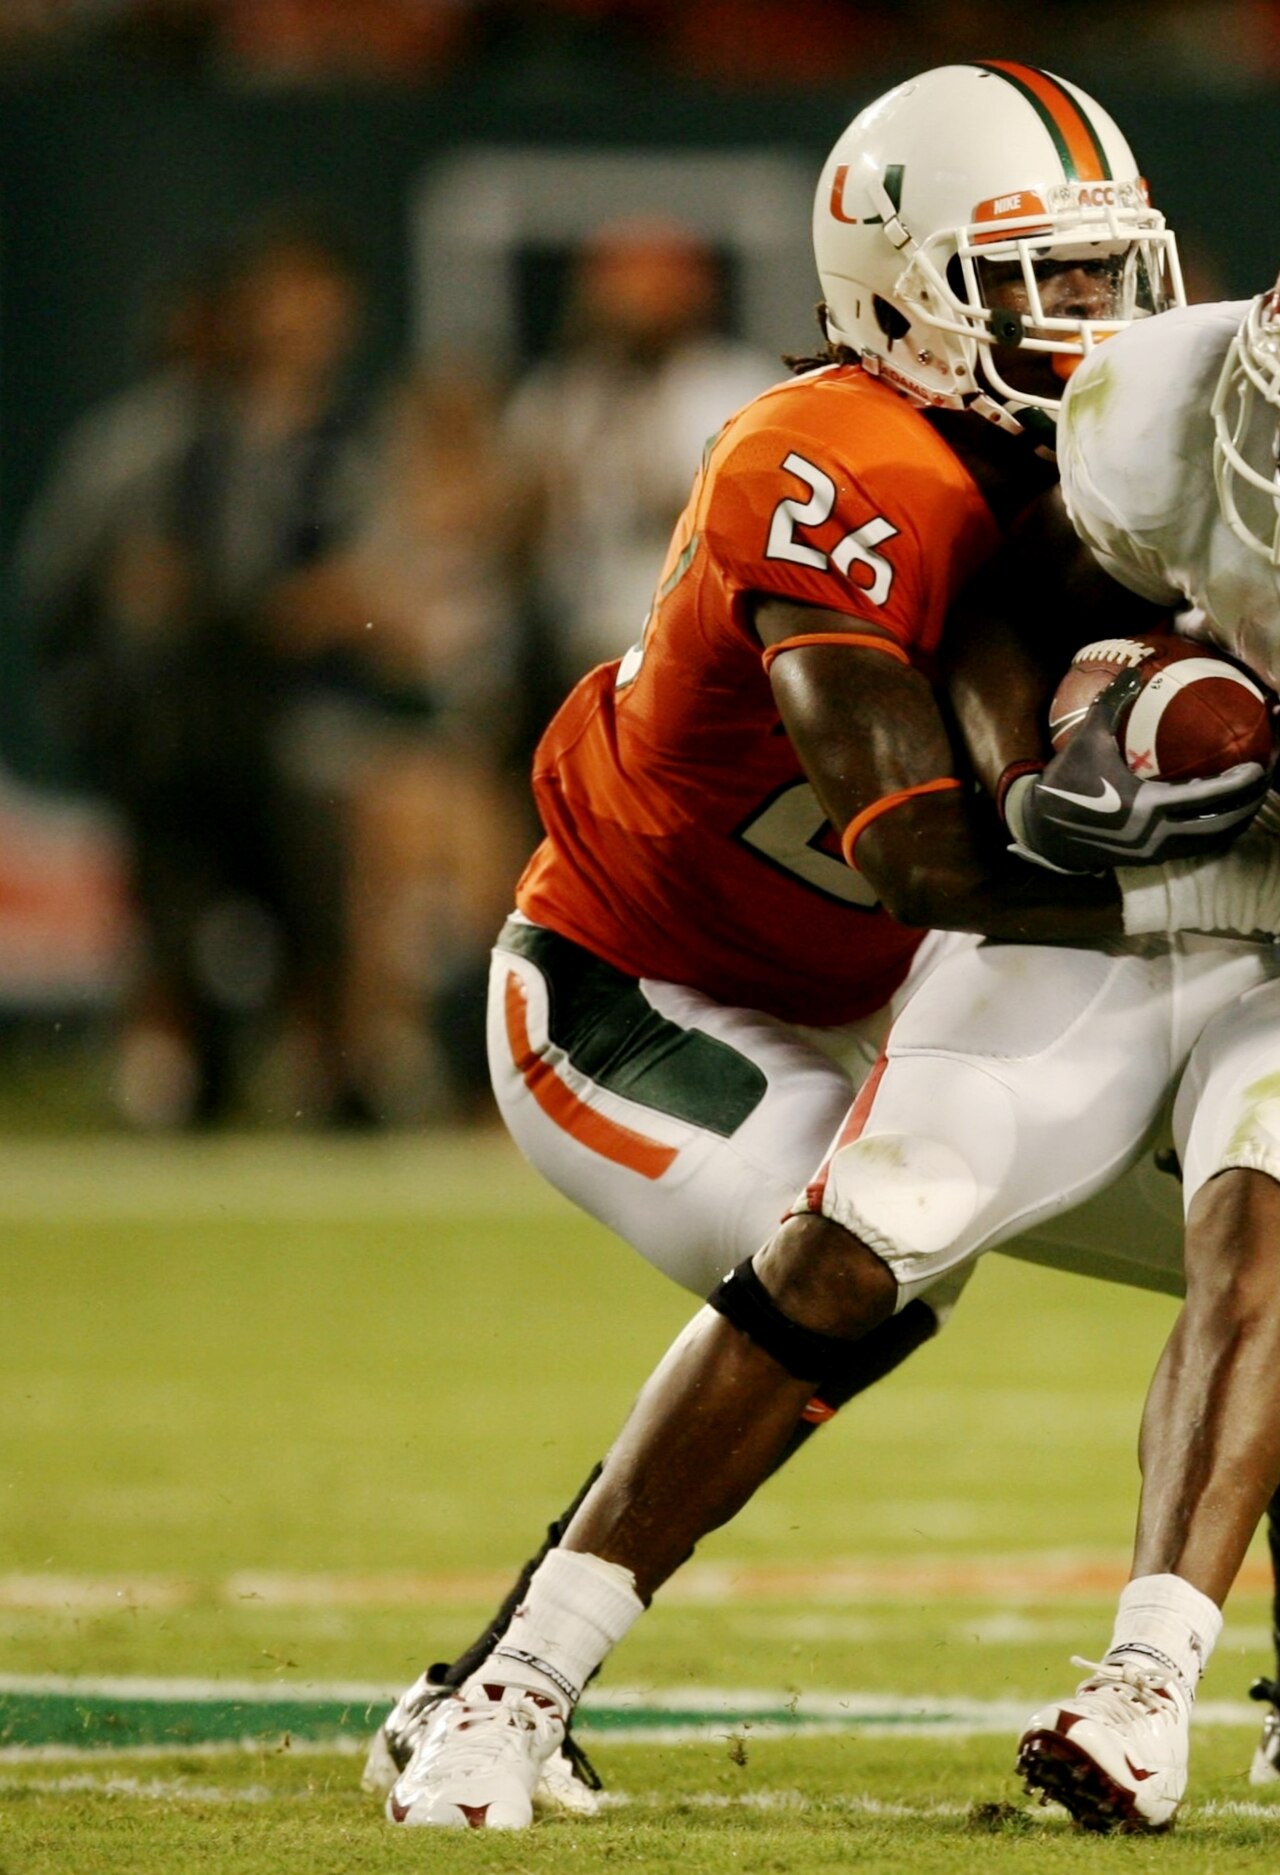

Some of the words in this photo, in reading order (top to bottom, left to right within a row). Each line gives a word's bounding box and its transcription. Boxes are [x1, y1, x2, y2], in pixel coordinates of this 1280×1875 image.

[829, 164, 906, 225] U
[994, 194, 1021, 215] NIKE
[1077, 187, 1115, 207] ACC
[766, 451, 900, 607] 26
